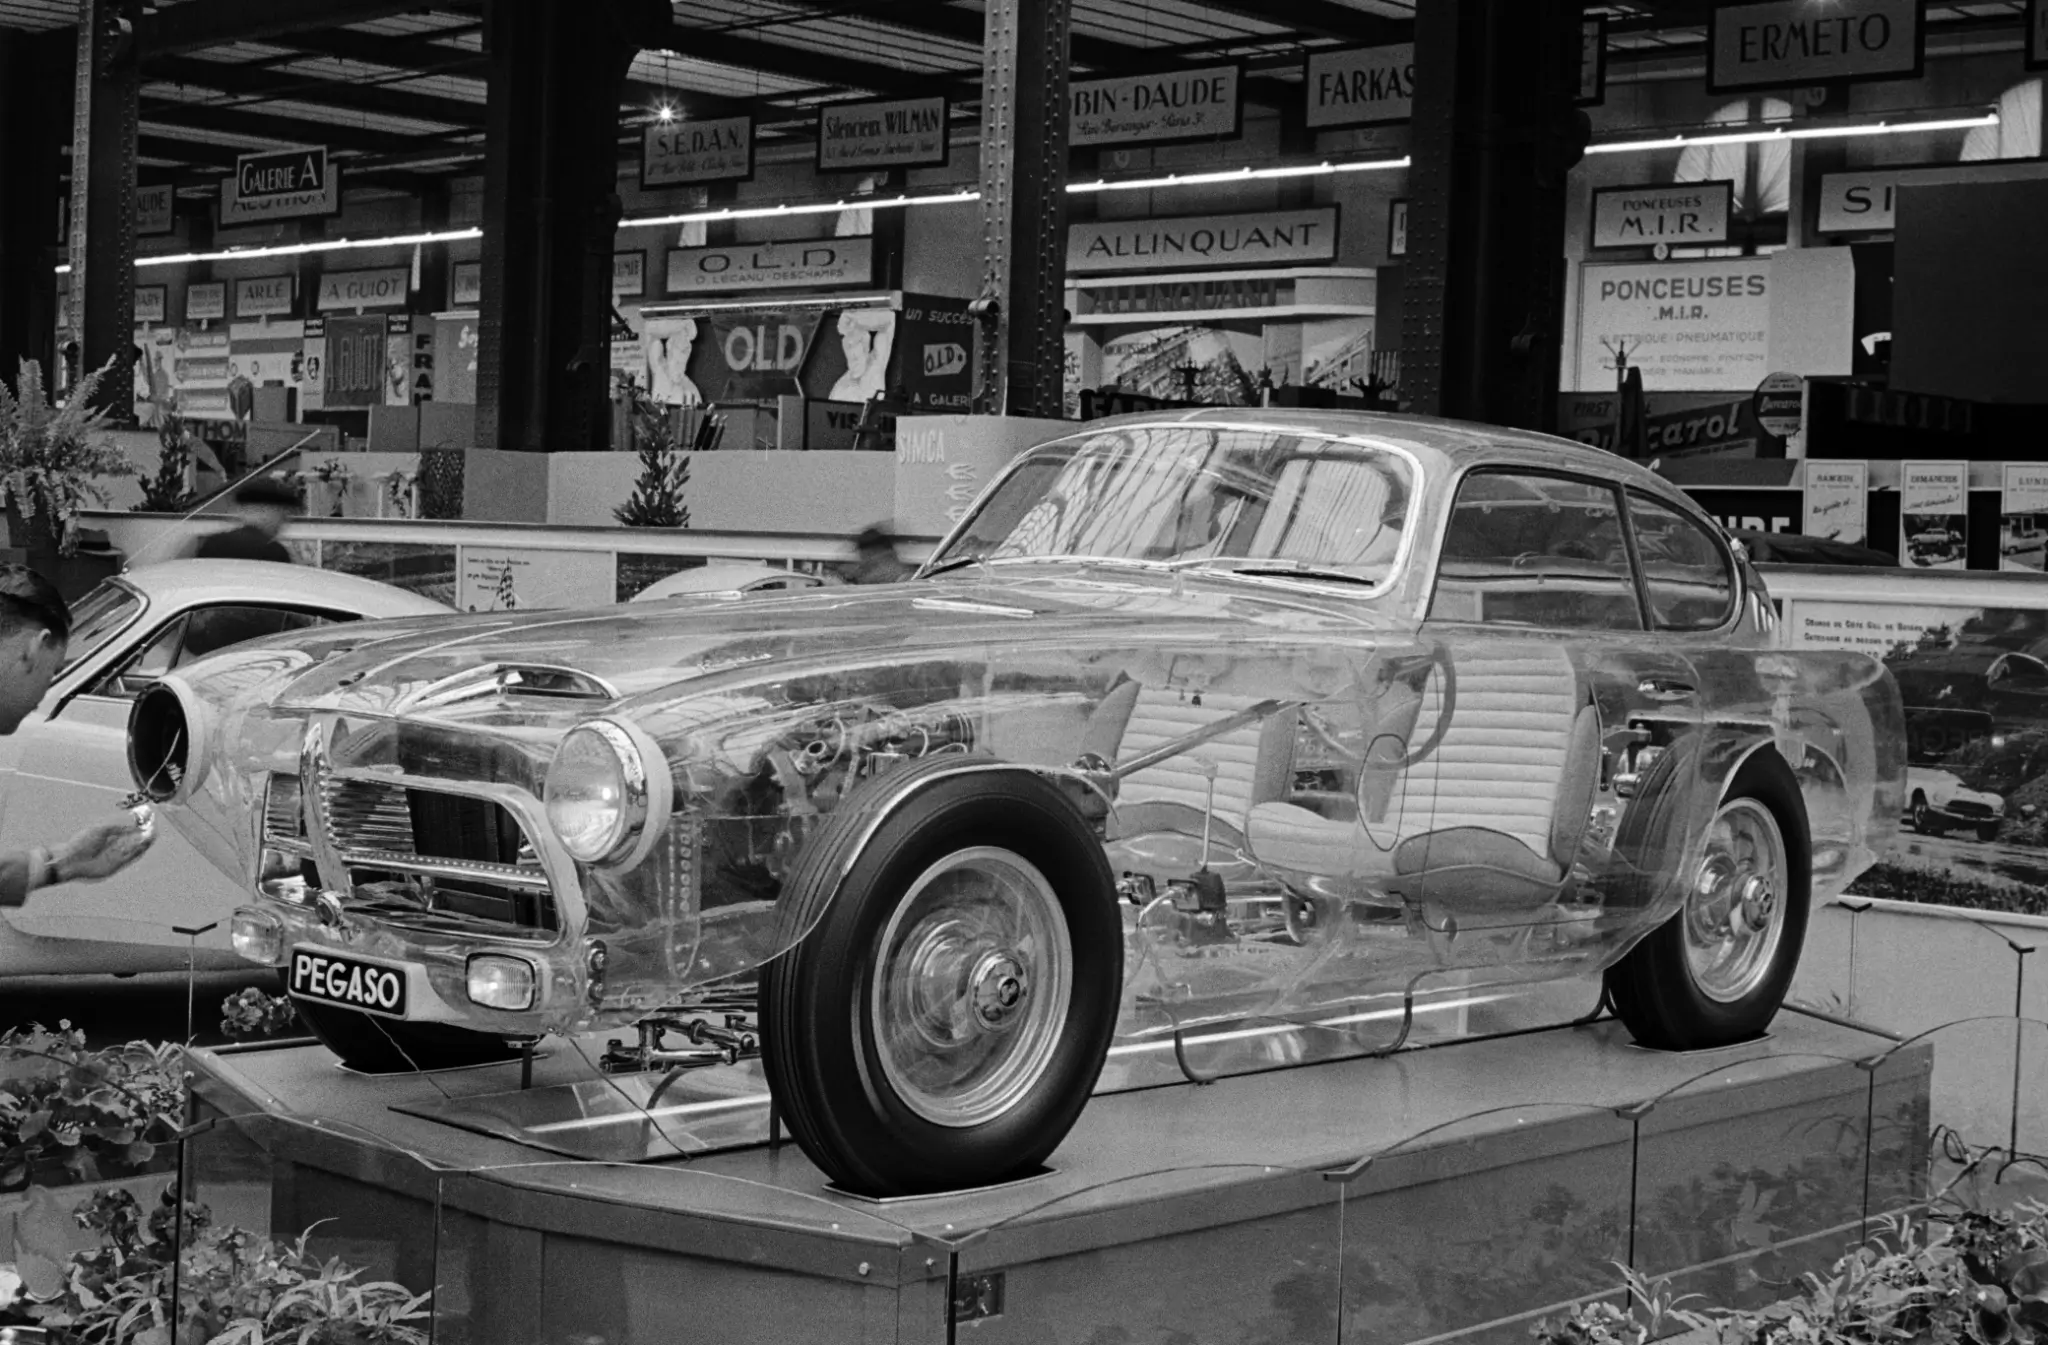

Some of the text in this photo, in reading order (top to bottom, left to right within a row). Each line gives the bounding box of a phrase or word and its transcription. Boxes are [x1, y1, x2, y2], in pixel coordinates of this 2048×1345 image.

[1740, 13, 1890, 63] ERMETO
[1069, 76, 1226, 116] BIN-DAUDE
[1319, 67, 1413, 106] FARKAS
[884, 108, 939, 135] WILMAN
[656, 127, 743, 157] S.E.D.A.N.
[298, 154, 318, 187] A
[1623, 195, 1702, 211] PONCEUSES
[1086, 223, 1316, 258] ALLINQUANT
[1619, 213, 1713, 237] M.I.R.
[697, 248, 847, 273] O.L.D.
[1600, 276, 1766, 301] PONCEUSES
[294, 954, 399, 1009] PEGASO
